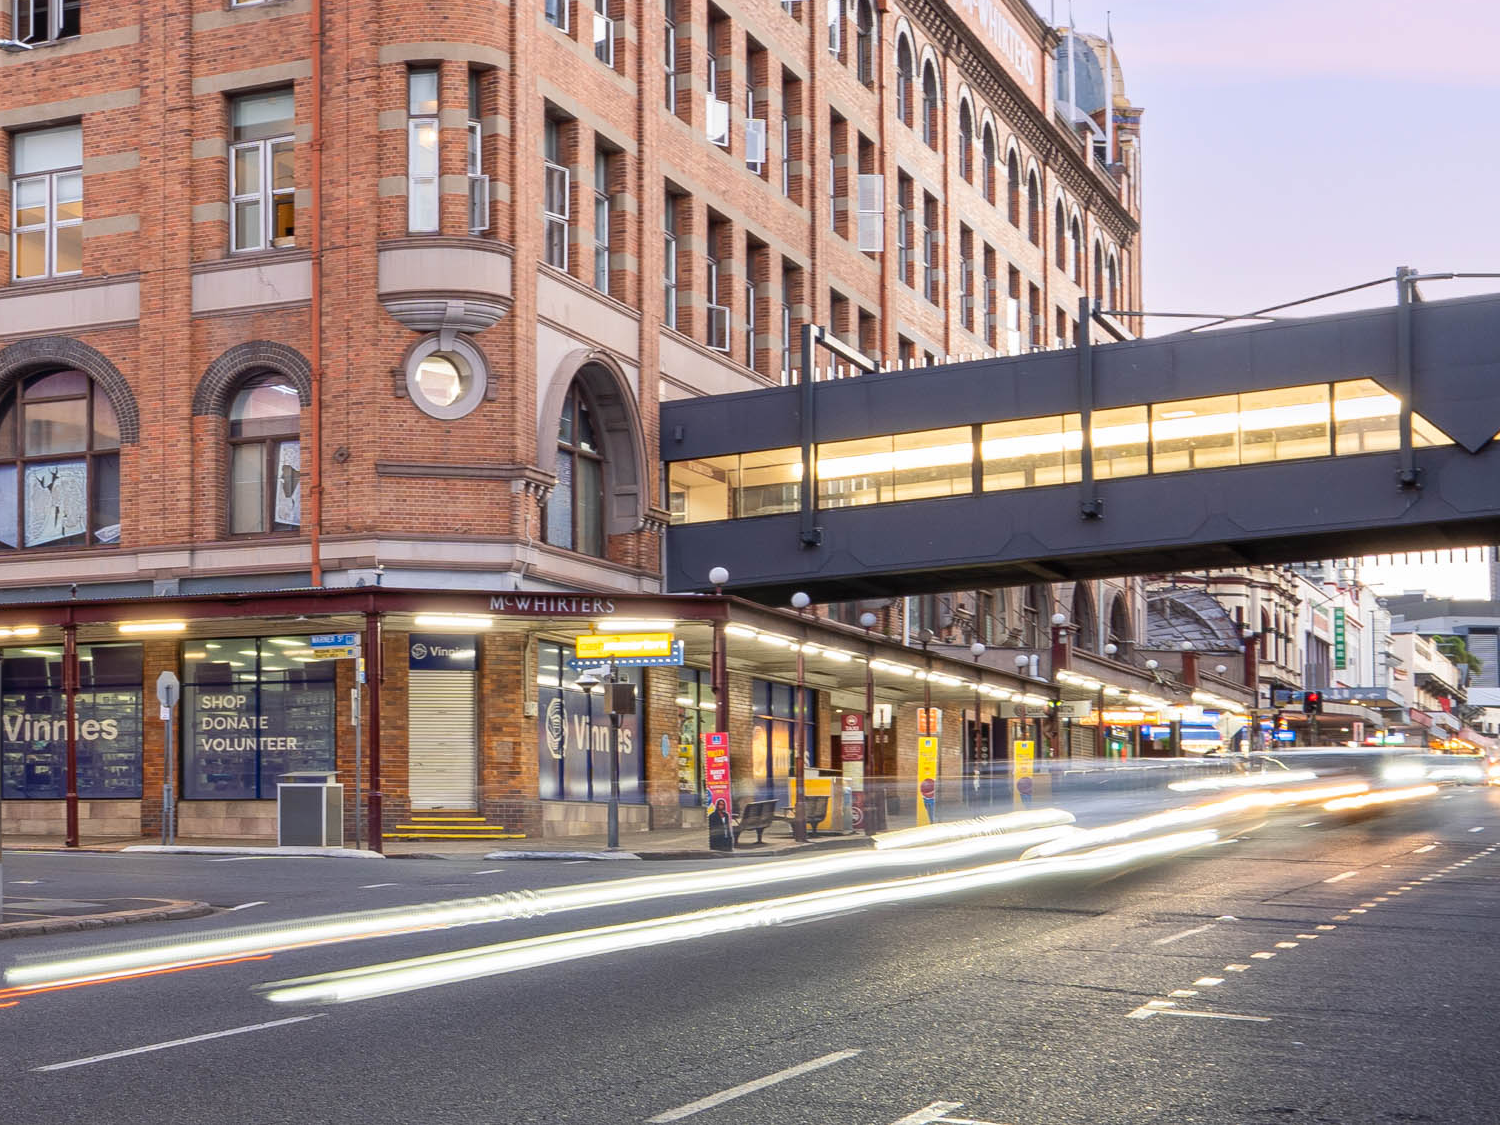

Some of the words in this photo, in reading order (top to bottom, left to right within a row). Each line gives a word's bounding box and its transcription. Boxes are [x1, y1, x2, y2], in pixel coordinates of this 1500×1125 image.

[202, 695, 247, 709] SHOP
[202, 716, 269, 730] DONATE
[574, 714, 633, 755] Vinnes
[201, 737, 298, 751] VOLUNTEER
